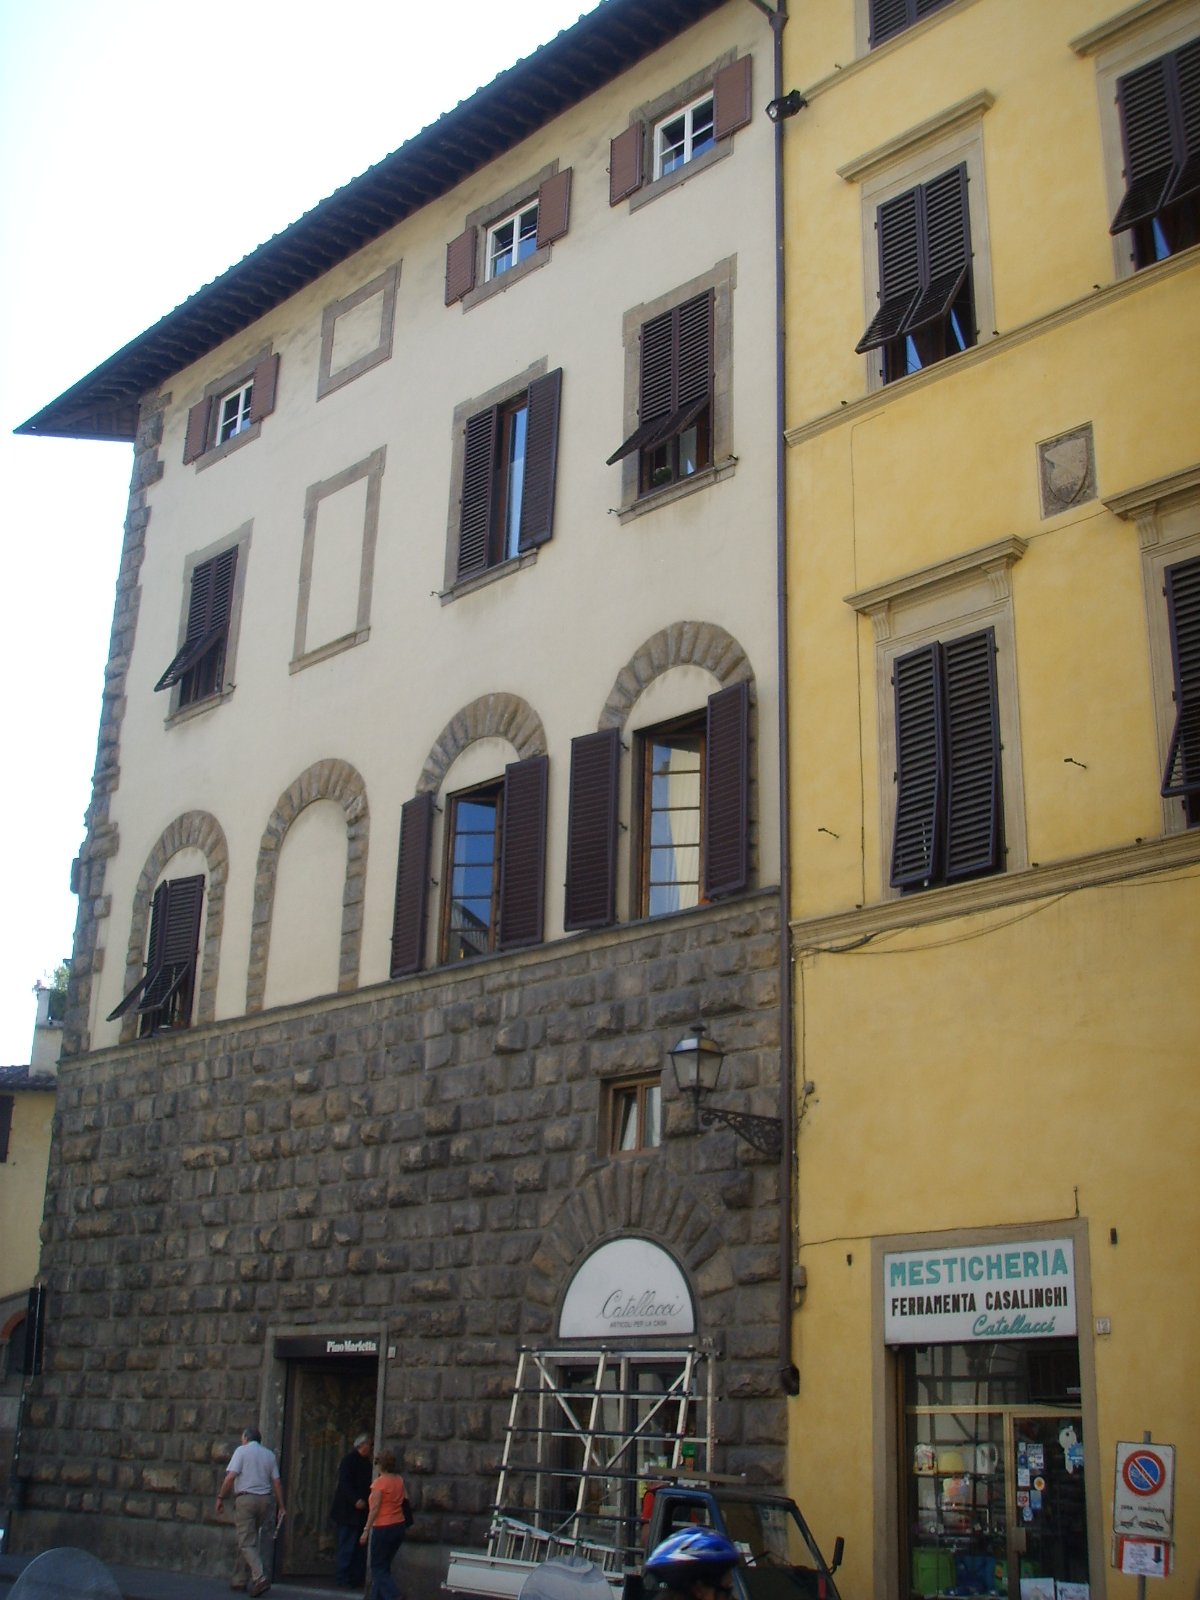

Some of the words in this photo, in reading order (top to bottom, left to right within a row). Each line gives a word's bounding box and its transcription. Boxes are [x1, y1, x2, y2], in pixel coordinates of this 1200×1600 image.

[890, 1248, 1068, 1287] MESTICHERIA
[892, 1293, 976, 1316] FERRAMENTA
[985, 1286, 1068, 1310] CASALINGHI
[972, 1314, 1056, 1336] Catellacci
